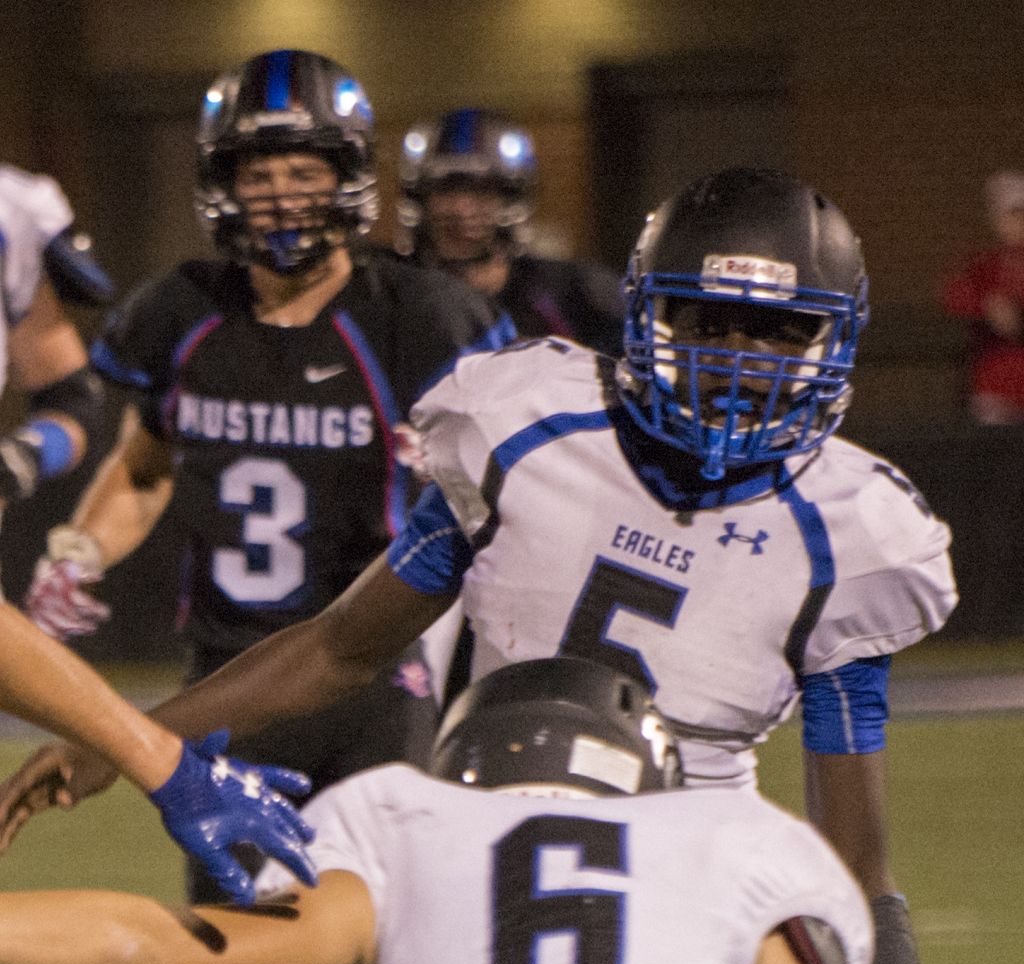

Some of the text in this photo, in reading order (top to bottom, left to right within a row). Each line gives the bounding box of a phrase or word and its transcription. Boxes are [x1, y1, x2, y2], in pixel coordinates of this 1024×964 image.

[177, 393, 373, 448] MUSTANGS
[212, 456, 311, 608] 3
[611, 525, 695, 574] EAGLES
[555, 554, 689, 699] 5
